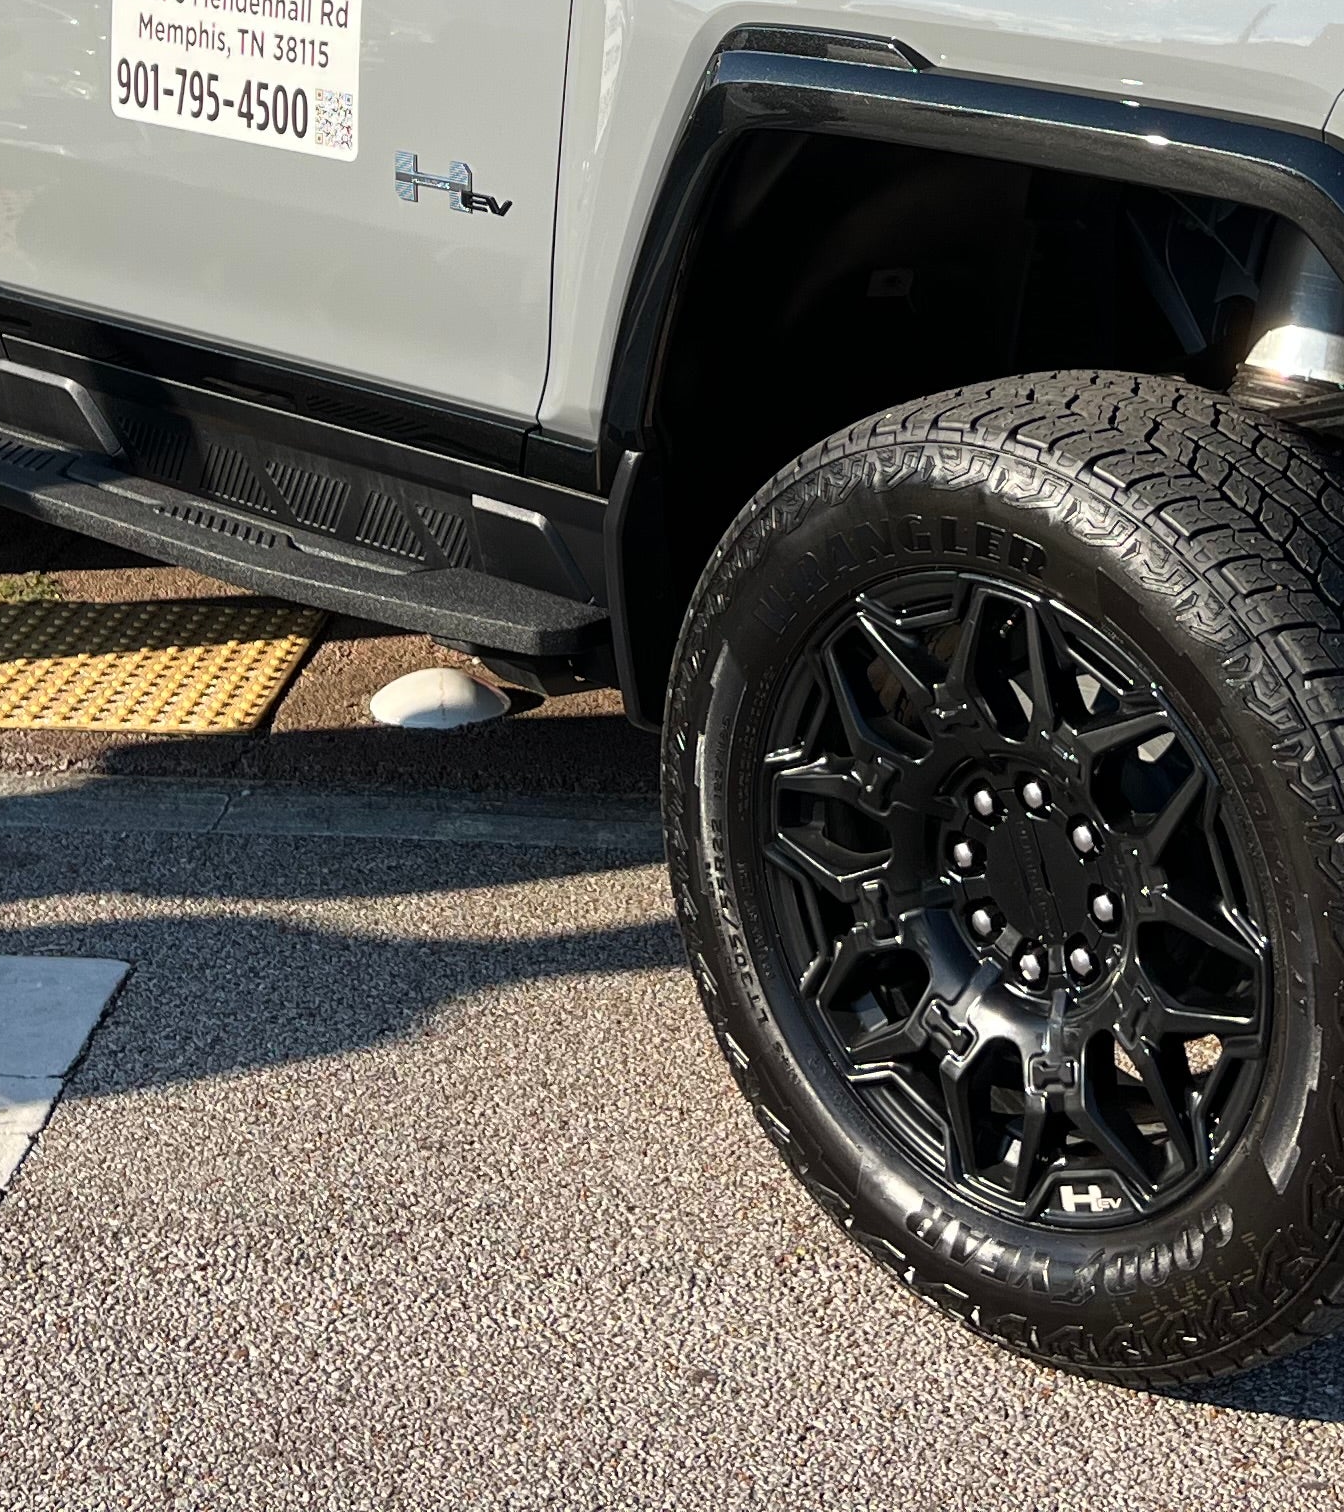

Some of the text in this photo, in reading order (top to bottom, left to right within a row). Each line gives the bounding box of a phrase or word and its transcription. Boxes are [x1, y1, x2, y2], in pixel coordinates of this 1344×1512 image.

[138, 12, 330, 68] Memphis, TN 38115
[117, 57, 309, 139] 901-795-4500
[752, 513, 1048, 635] WRANGLER
